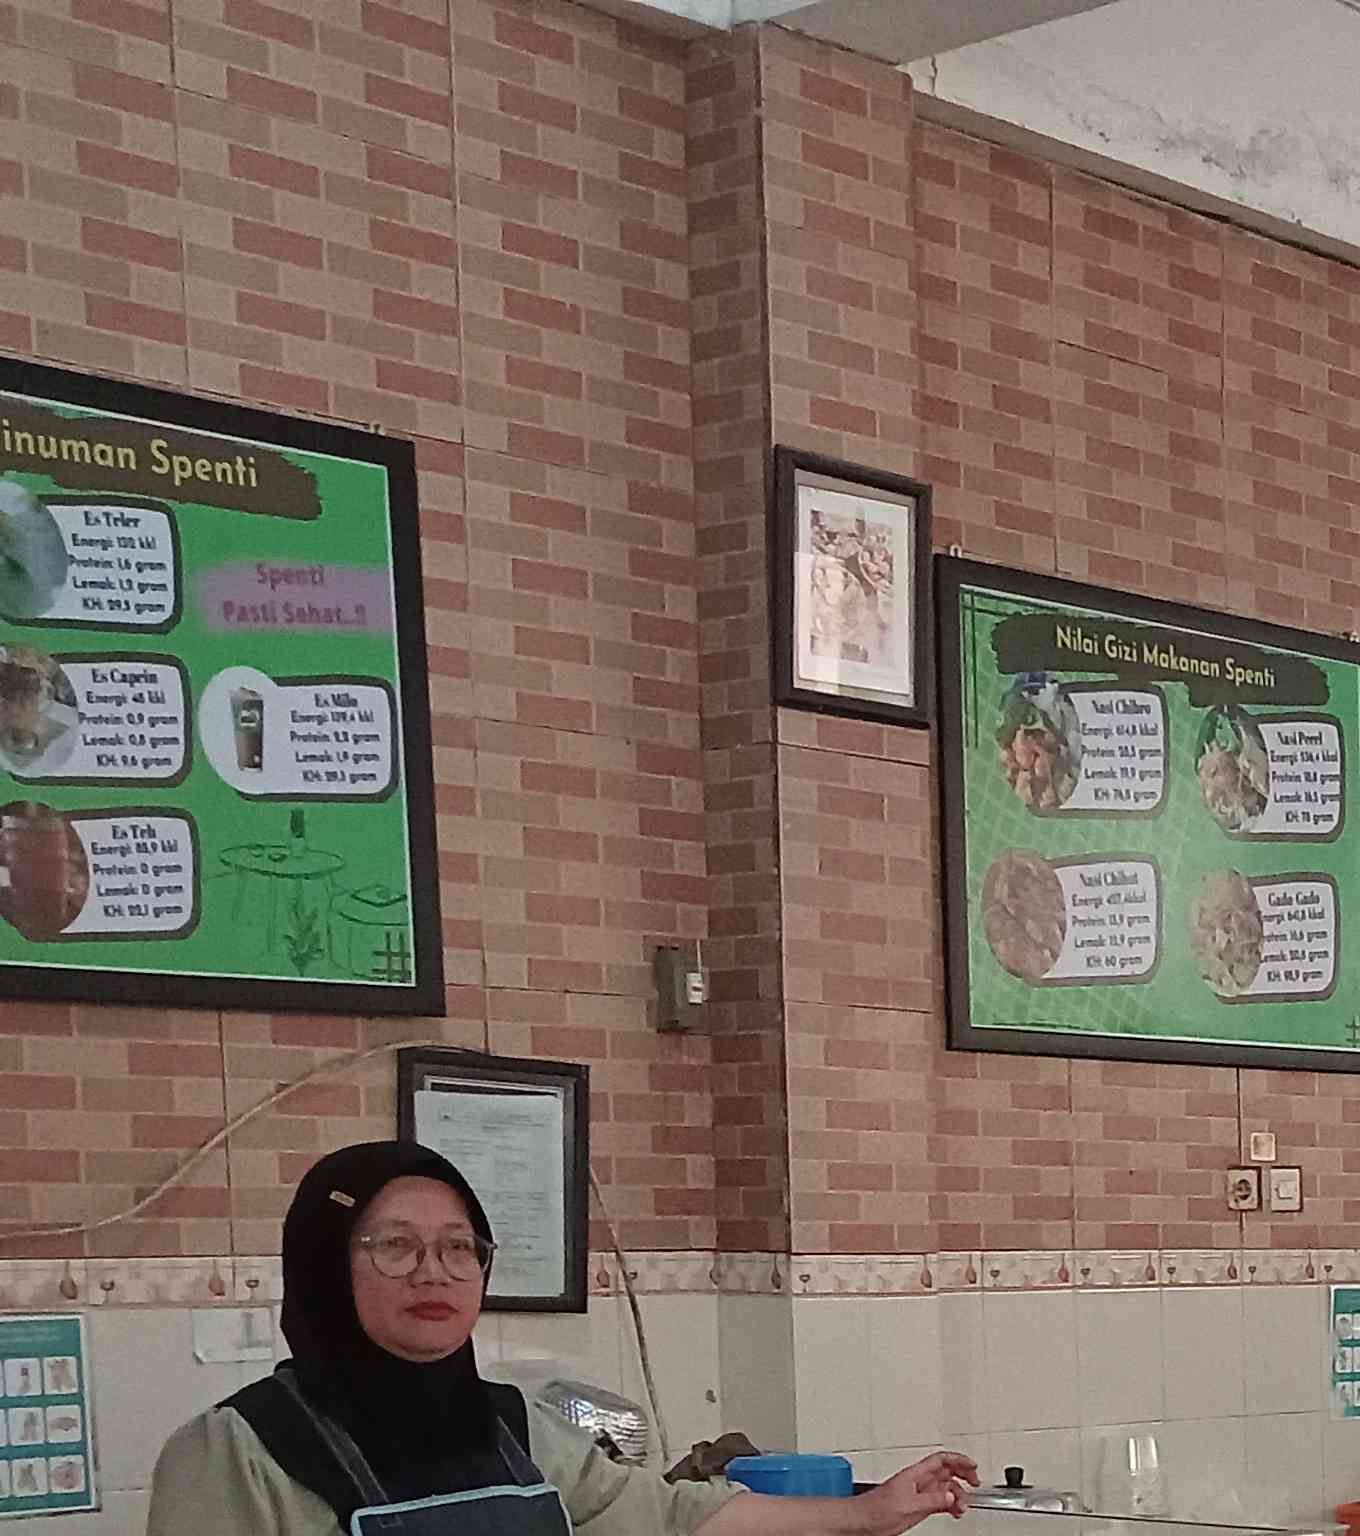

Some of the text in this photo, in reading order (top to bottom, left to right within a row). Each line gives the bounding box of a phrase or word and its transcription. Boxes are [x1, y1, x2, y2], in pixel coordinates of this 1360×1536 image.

[151, 438, 258, 488] Spenti
[1056, 623, 1275, 688] Nilai Gizi Makanan Spenti
[91, 669, 108, 683] Es
[148, 716, 179, 728] gram
[150, 737, 180, 749] gram
[142, 757, 172, 769] gram
[152, 864, 183, 877] gram
[154, 885, 183, 897] gram
[1268, 890, 1320, 906] Gado Gado
[153, 906, 183, 918] gram
